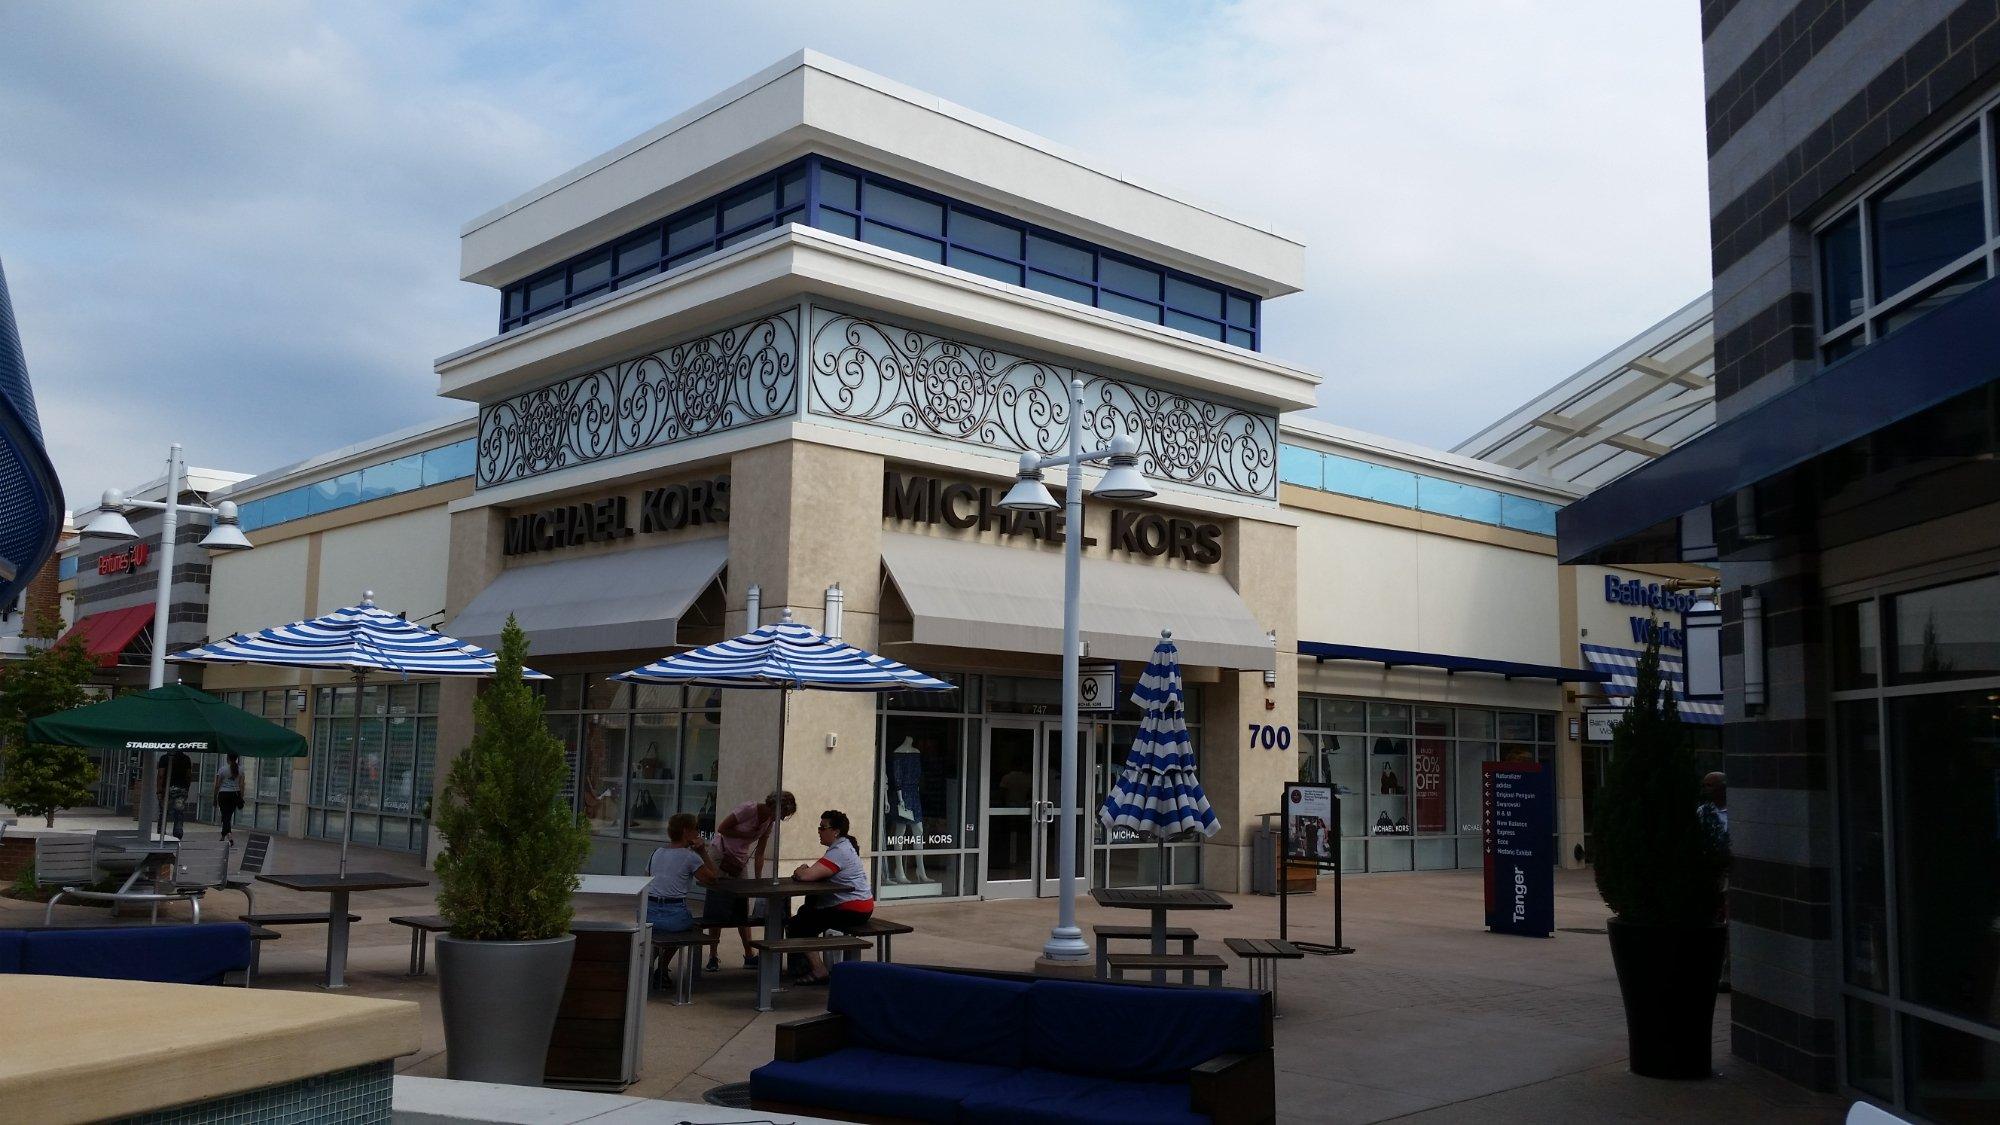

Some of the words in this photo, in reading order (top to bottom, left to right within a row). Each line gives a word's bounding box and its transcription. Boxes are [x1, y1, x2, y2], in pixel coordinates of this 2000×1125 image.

[503, 496, 635, 555] MICHAEL
[640, 475, 731, 533] KORS
[1111, 508, 1222, 565] KORS
[1032, 705, 1047, 714] 747
[1248, 724, 1291, 750] 700
[1415, 755, 1439, 773] 50%
[1416, 773, 1440, 790] OFF
[887, 835, 926, 845] MICHAEL
[928, 834, 953, 844] KORS
[1512, 866, 1528, 923] Tanger
